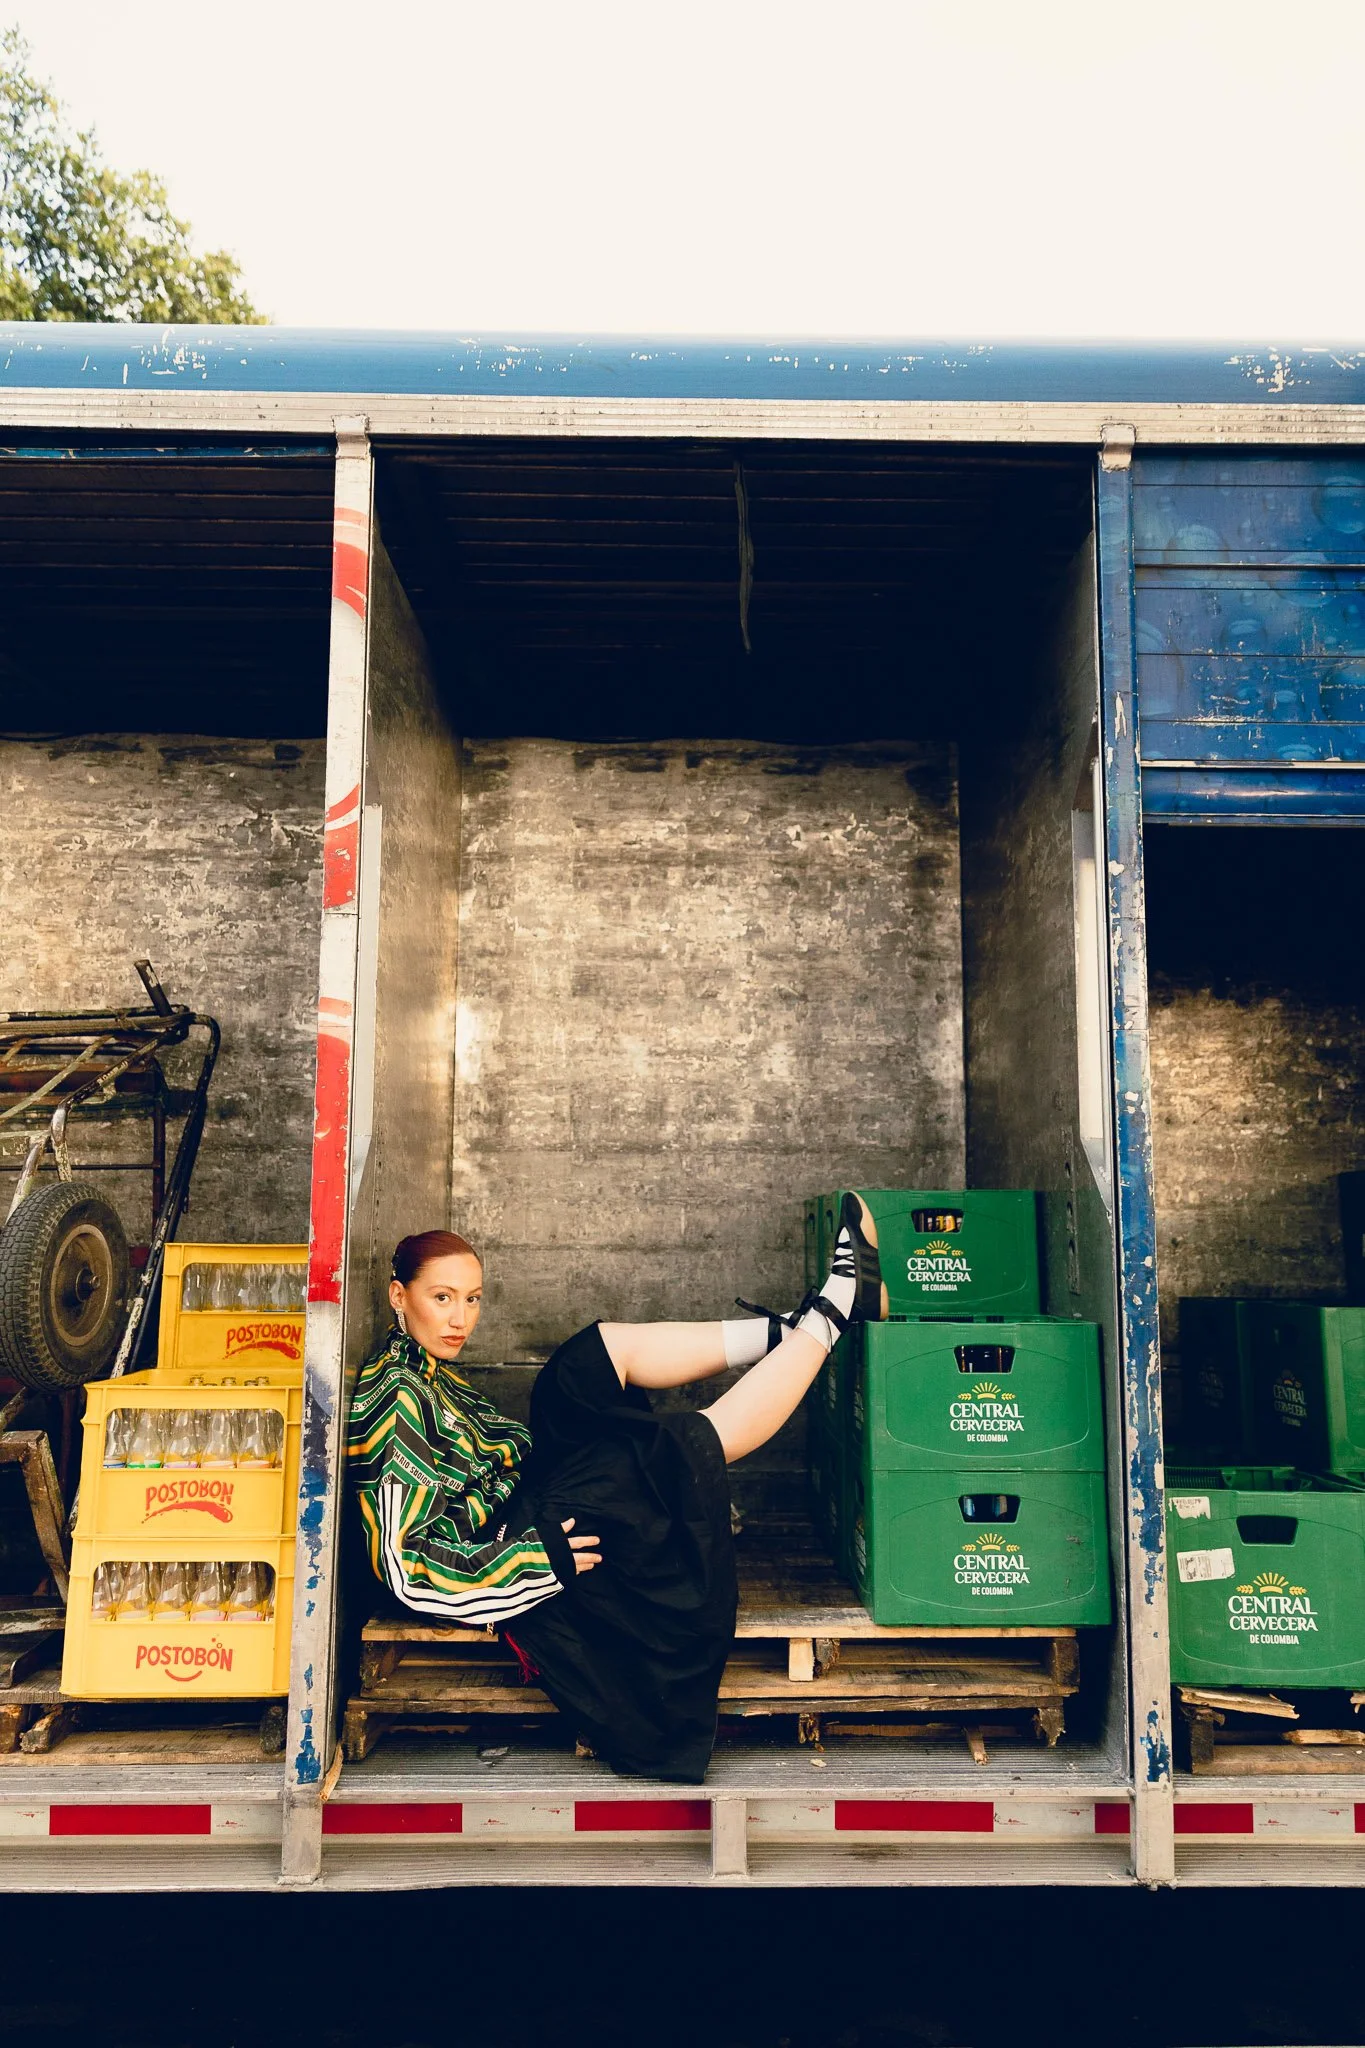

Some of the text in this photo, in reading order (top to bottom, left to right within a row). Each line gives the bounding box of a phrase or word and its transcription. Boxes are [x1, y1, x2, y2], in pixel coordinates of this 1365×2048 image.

[906, 1257, 972, 1271] CENTRAL
[907, 1271, 972, 1282] CERVECERA
[921, 1283, 958, 1291] DE COLOMBIA
[226, 1323, 302, 1349] POSTOBON
[949, 1402, 1025, 1418] CENTRAL
[950, 1419, 1025, 1431] CERVECERA
[966, 1433, 1009, 1442] DE COLOMBIA
[953, 1554, 1031, 1570] CENTRAL
[954, 1571, 1031, 1584] CERVECERA
[971, 1586, 1014, 1595] DE COLOMBIA
[1227, 1595, 1319, 1615] CENTRAL
[1229, 1615, 1319, 1632] CERVECERA
[1249, 1634, 1300, 1645] DE COLOMBIA
